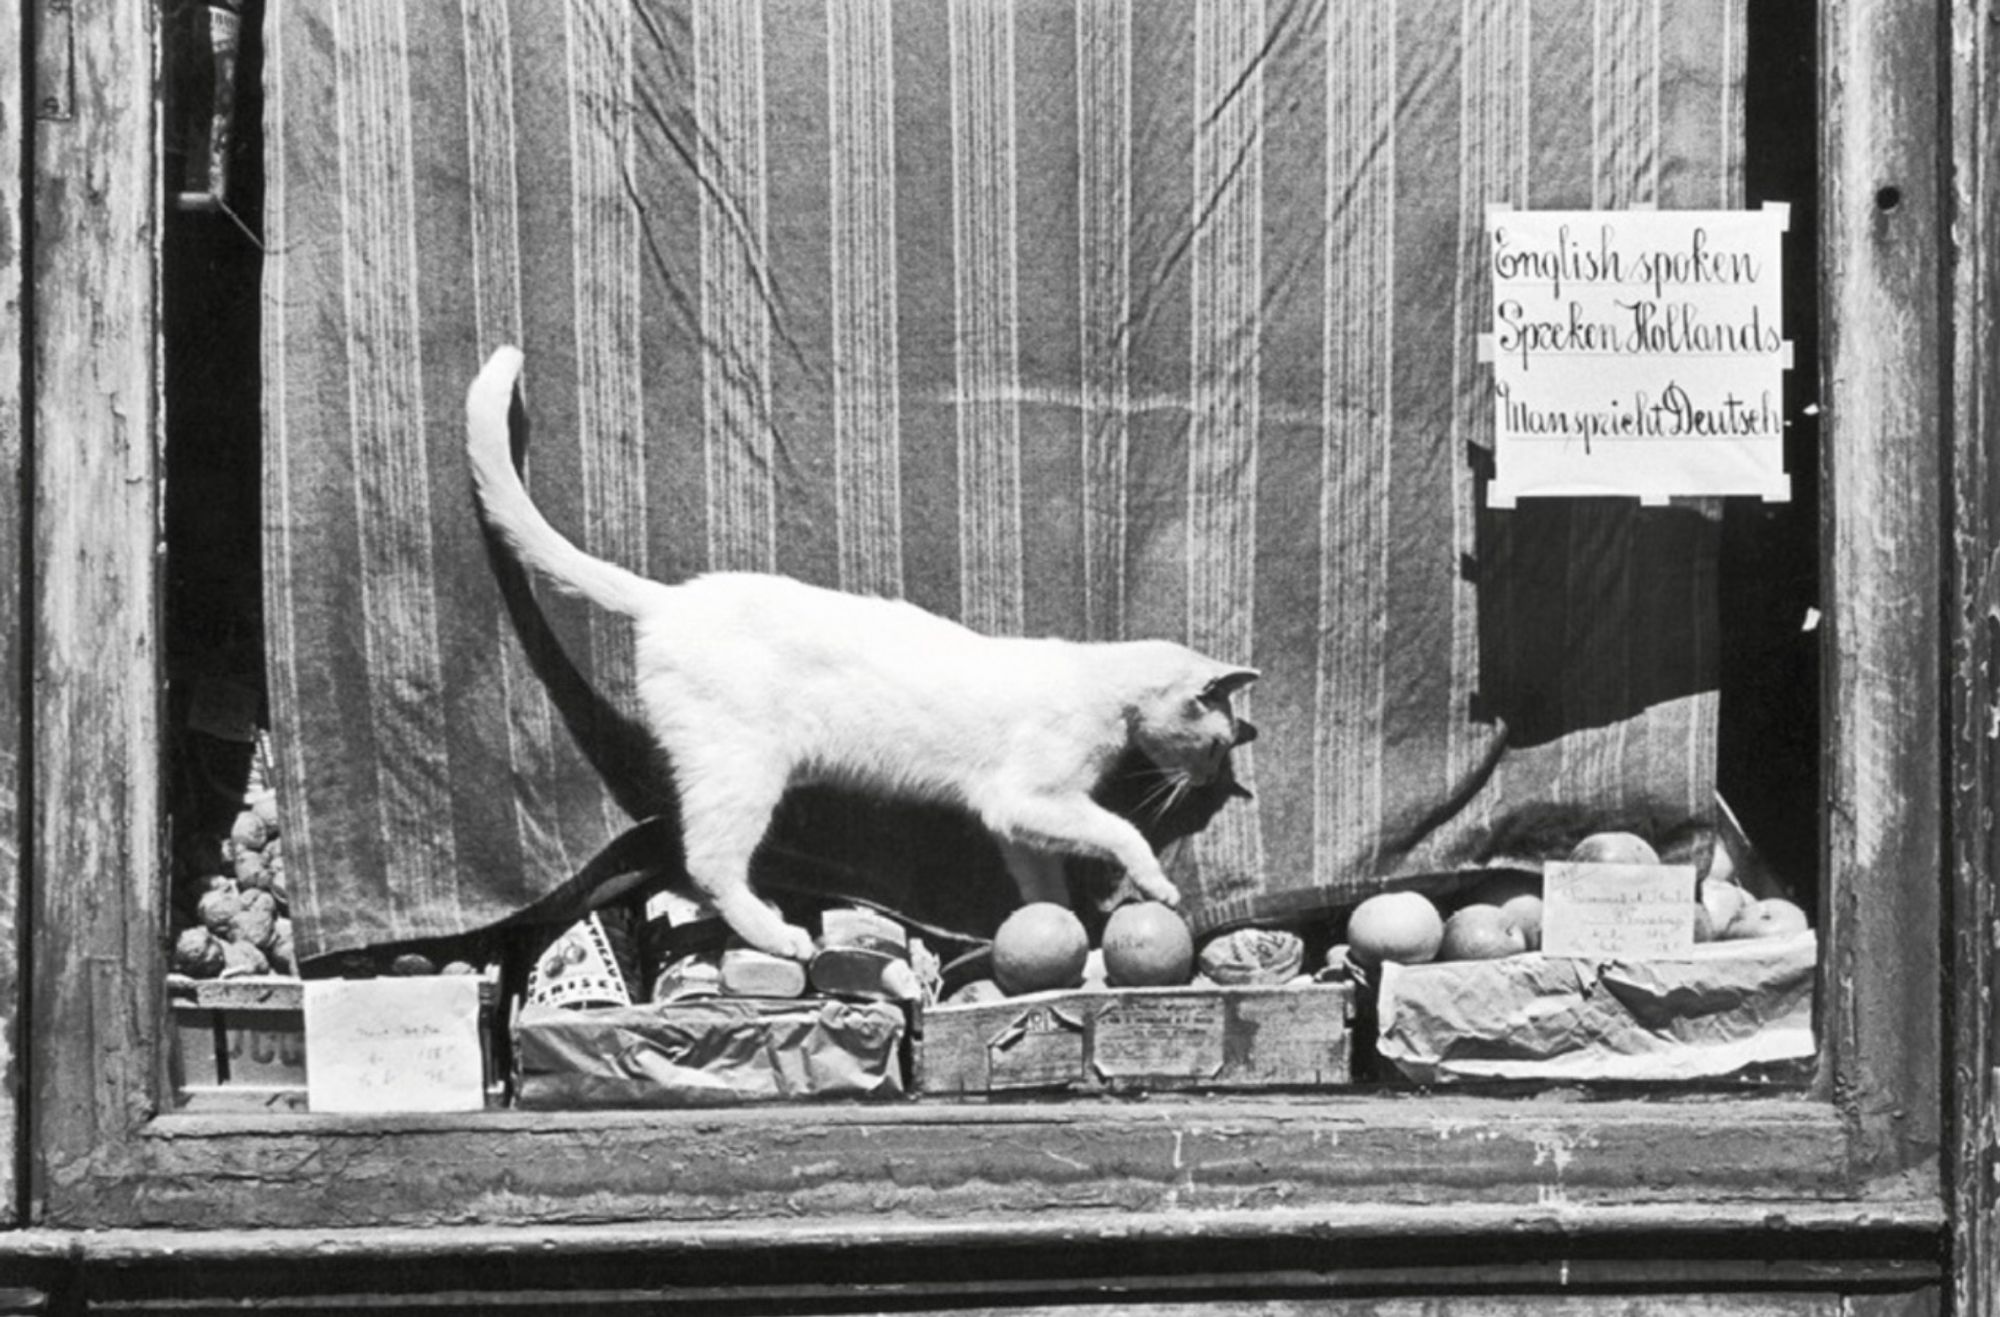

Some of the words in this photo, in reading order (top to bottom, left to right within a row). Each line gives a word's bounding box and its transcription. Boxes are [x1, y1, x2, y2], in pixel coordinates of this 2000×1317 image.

[1495, 223, 1628, 300] English
[1629, 227, 1762, 299] spoken
[1613, 299, 1781, 353] Hollands
[1496, 380, 1569, 434] Man
[1661, 379, 1781, 436] Deutsch
